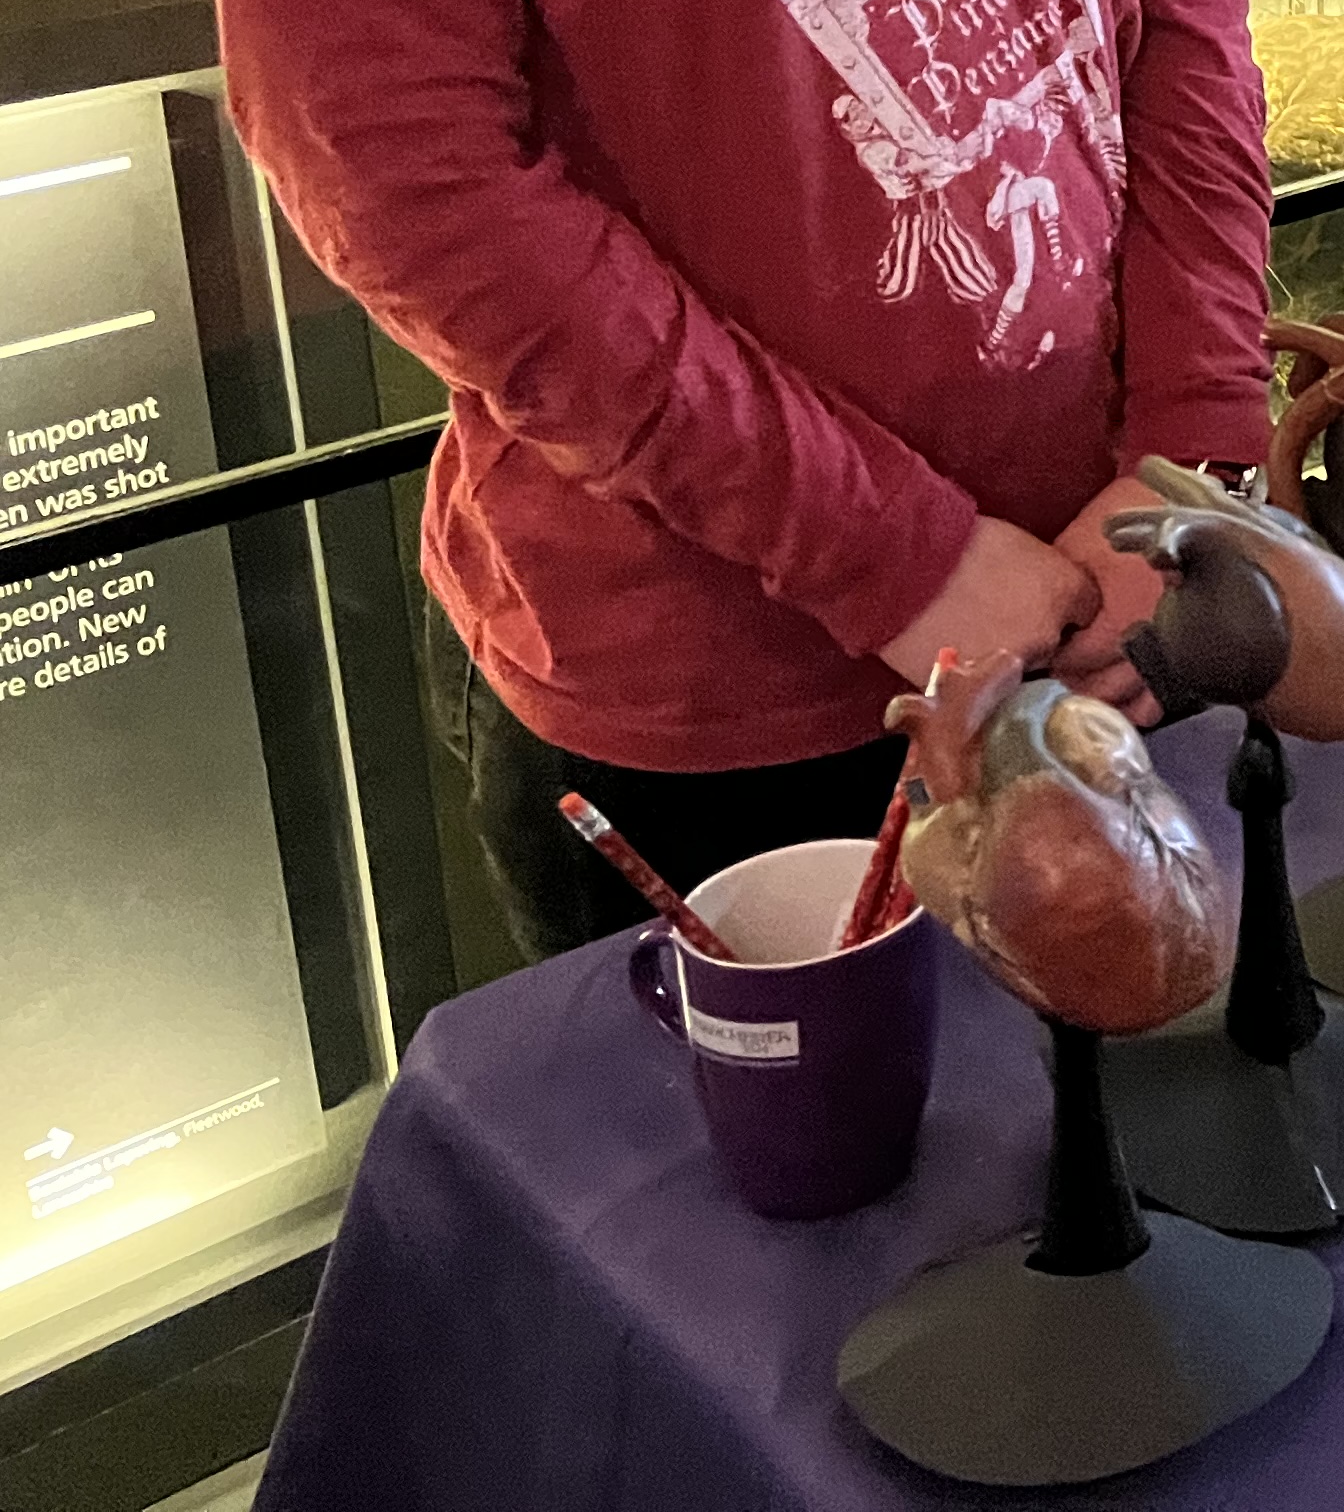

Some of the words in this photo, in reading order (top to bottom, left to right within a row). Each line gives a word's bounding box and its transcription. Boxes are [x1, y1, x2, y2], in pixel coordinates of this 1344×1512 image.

[7, 396, 160, 457] important
[3, 433, 149, 492] extremely
[35, 484, 98, 517] was
[104, 461, 170, 499] shot
[0, 586, 95, 638] people
[102, 570, 155, 600] can
[0, 631, 70, 667] tion.
[78, 604, 147, 641] New
[34, 641, 130, 689] details
[137, 625, 167, 656] of
